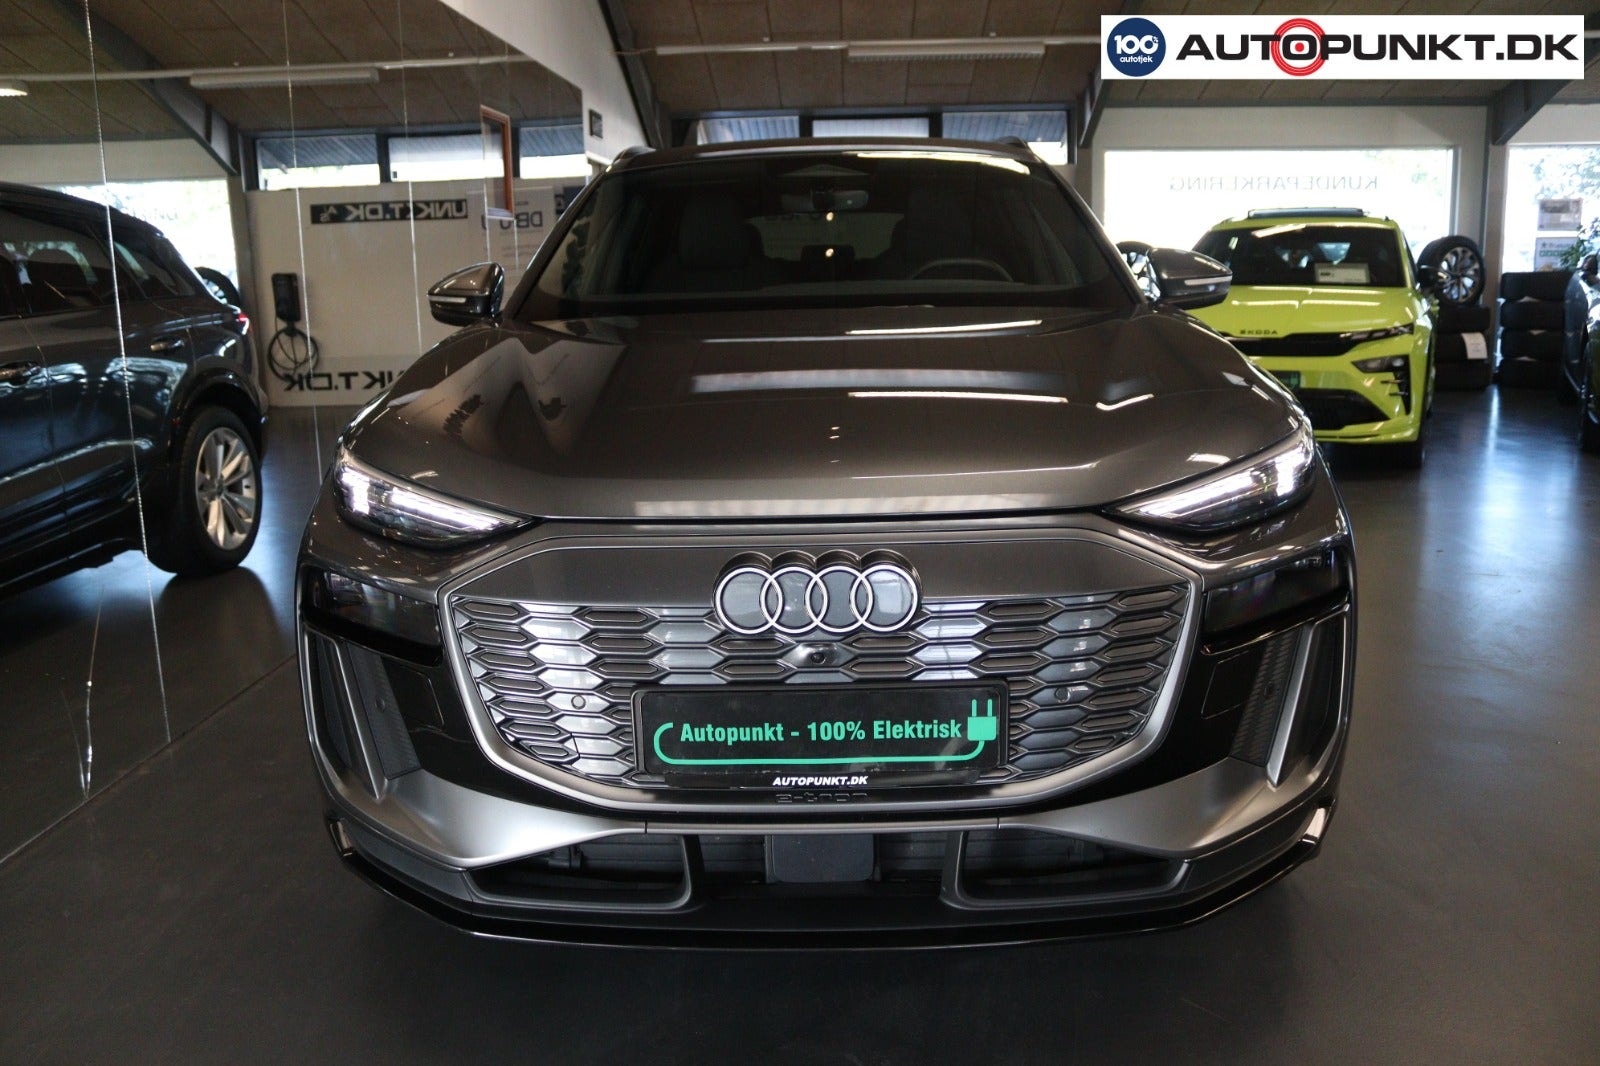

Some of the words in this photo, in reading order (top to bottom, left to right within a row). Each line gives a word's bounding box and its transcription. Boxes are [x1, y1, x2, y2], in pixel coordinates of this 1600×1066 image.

[680, 722, 784, 746] Autopunkt
[807, 720, 866, 742] 100%
[873, 719, 962, 740] Elektrisk
[772, 775, 868, 786] AUTOPUNKT.DK
